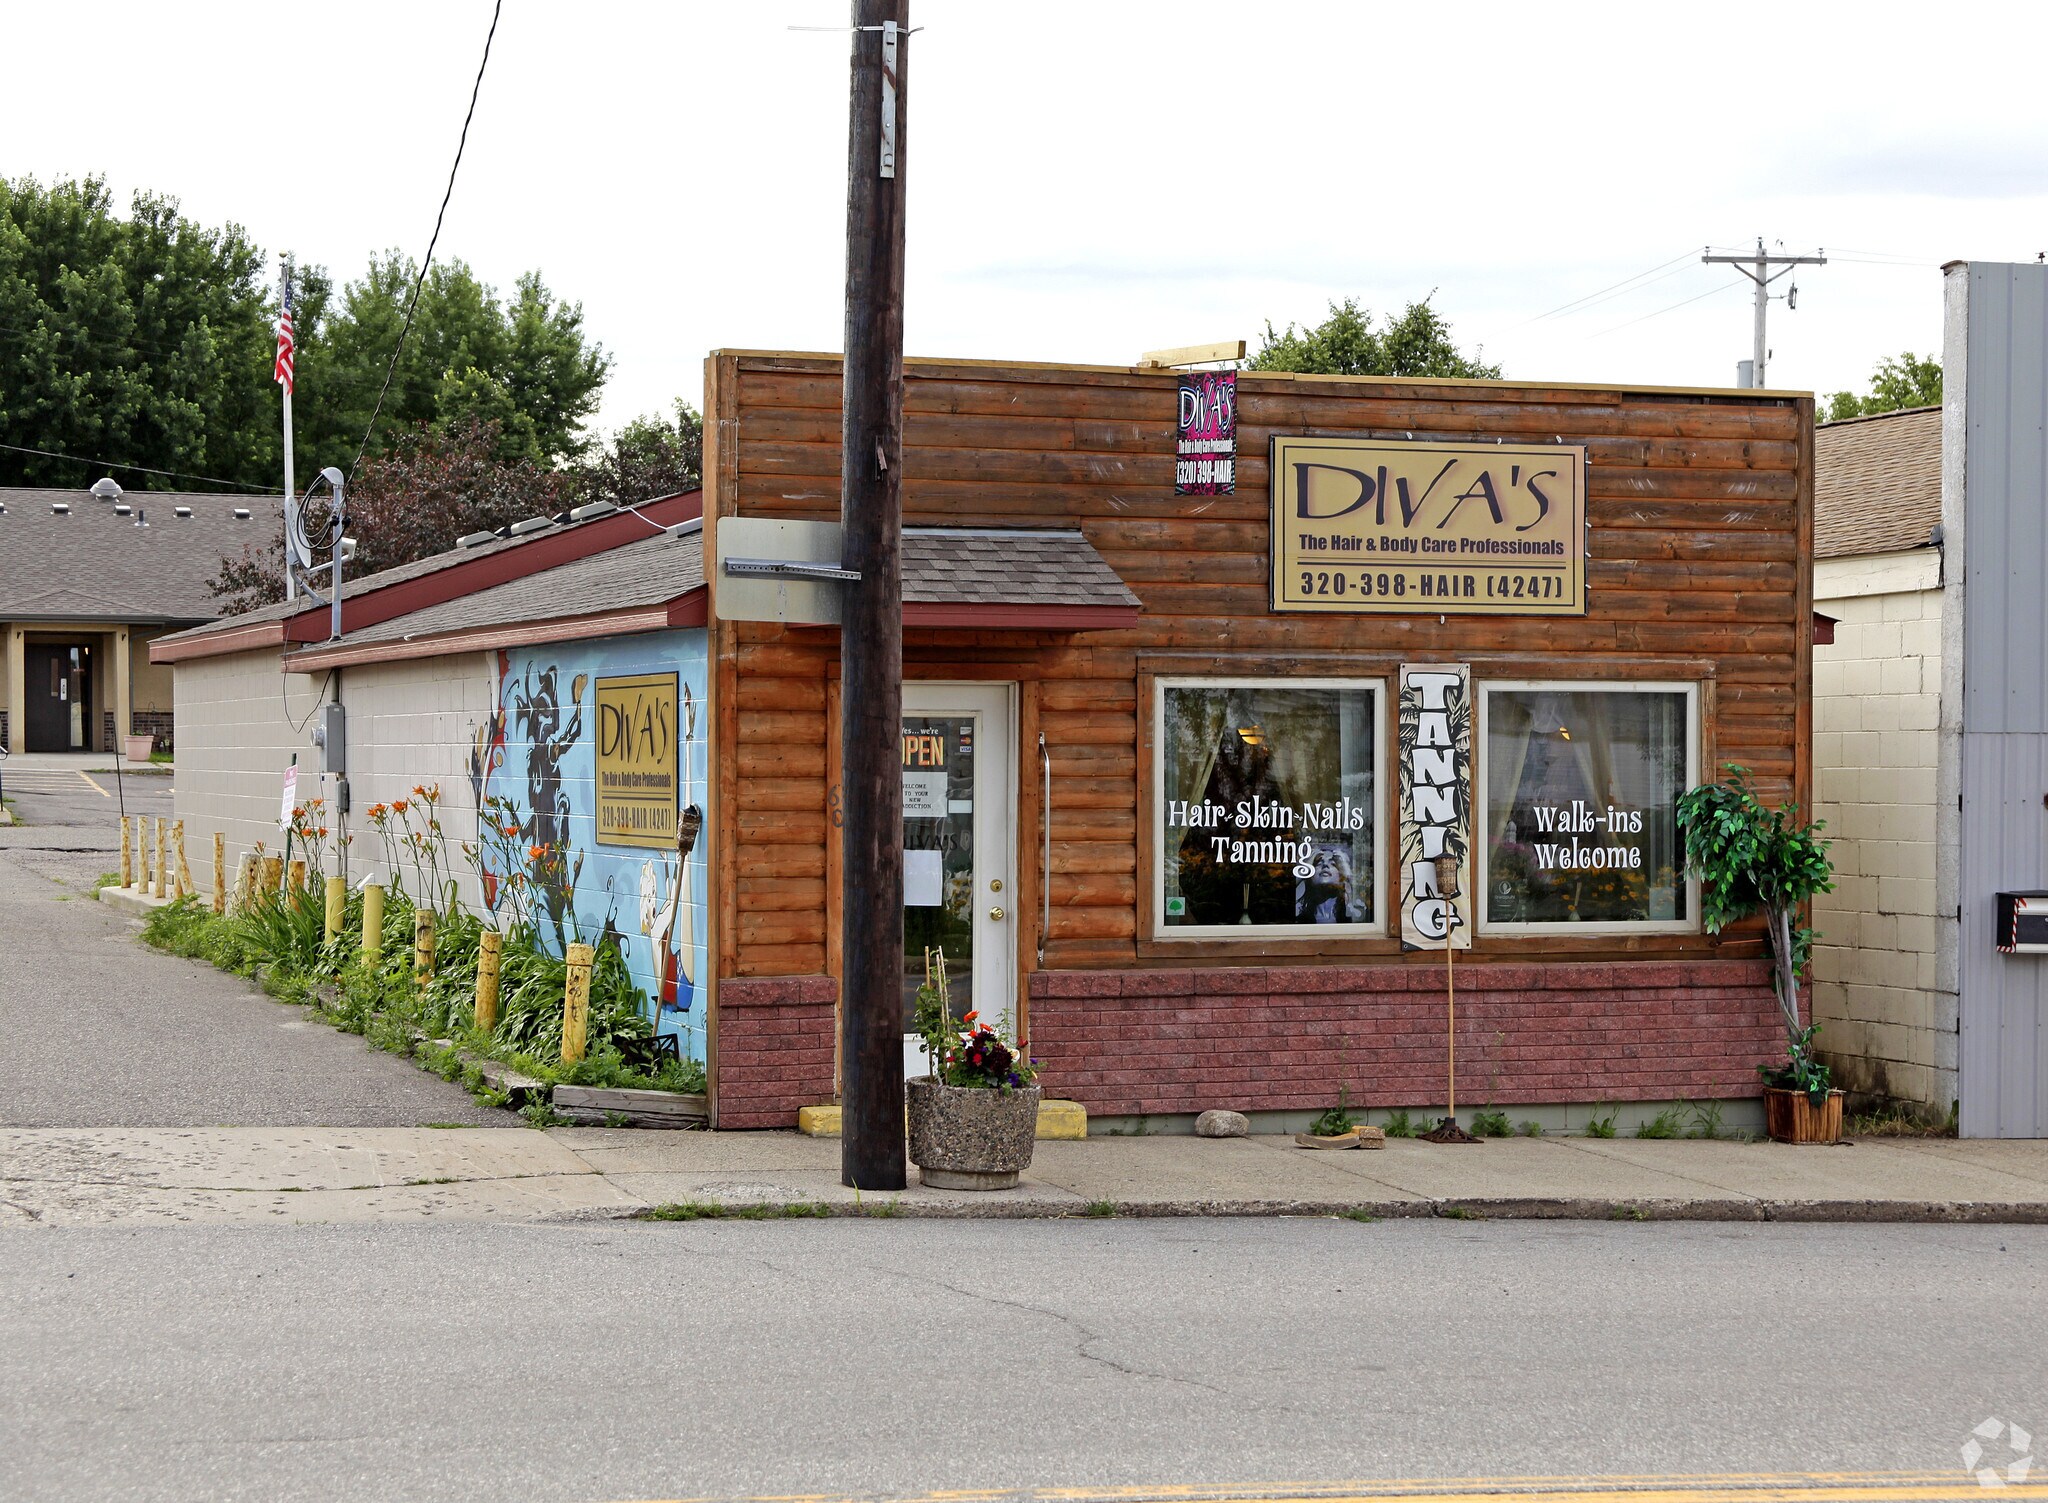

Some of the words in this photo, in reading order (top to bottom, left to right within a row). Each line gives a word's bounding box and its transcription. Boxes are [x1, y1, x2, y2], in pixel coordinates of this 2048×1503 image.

[1179, 379, 1235, 434] DIVA'S
[1177, 460, 1197, 484] (320)
[1198, 459, 1232, 484] 398-HAIR
[1292, 458, 1558, 532] DIVA'S
[1299, 534, 1328, 551] The
[1331, 534, 1363, 552] Hair
[1366, 537, 1378, 551] &
[1380, 536, 1418, 554] Body
[1421, 537, 1457, 553] Care
[1460, 538, 1565, 555] Professionals
[1301, 572, 1476, 597] 320-398-HAIR
[1487, 575, 1563, 598] (4247)
[600, 693, 669, 764] DIVA'S
[920, 727, 939, 735] we're
[622, 771, 631, 788] Body
[632, 771, 641, 787] Care
[642, 772, 671, 788] Professionals
[602, 805, 647, 829] 320-398-HAIR
[650, 807, 671, 831] (4247)
[1169, 798, 1226, 827] Hair
[1235, 795, 1294, 828] Skin
[1302, 796, 1364, 830] Nails
[1533, 800, 1643, 833] Walk-ins
[1211, 835, 1316, 879] Tanning
[1534, 836, 1642, 869] Welcome
